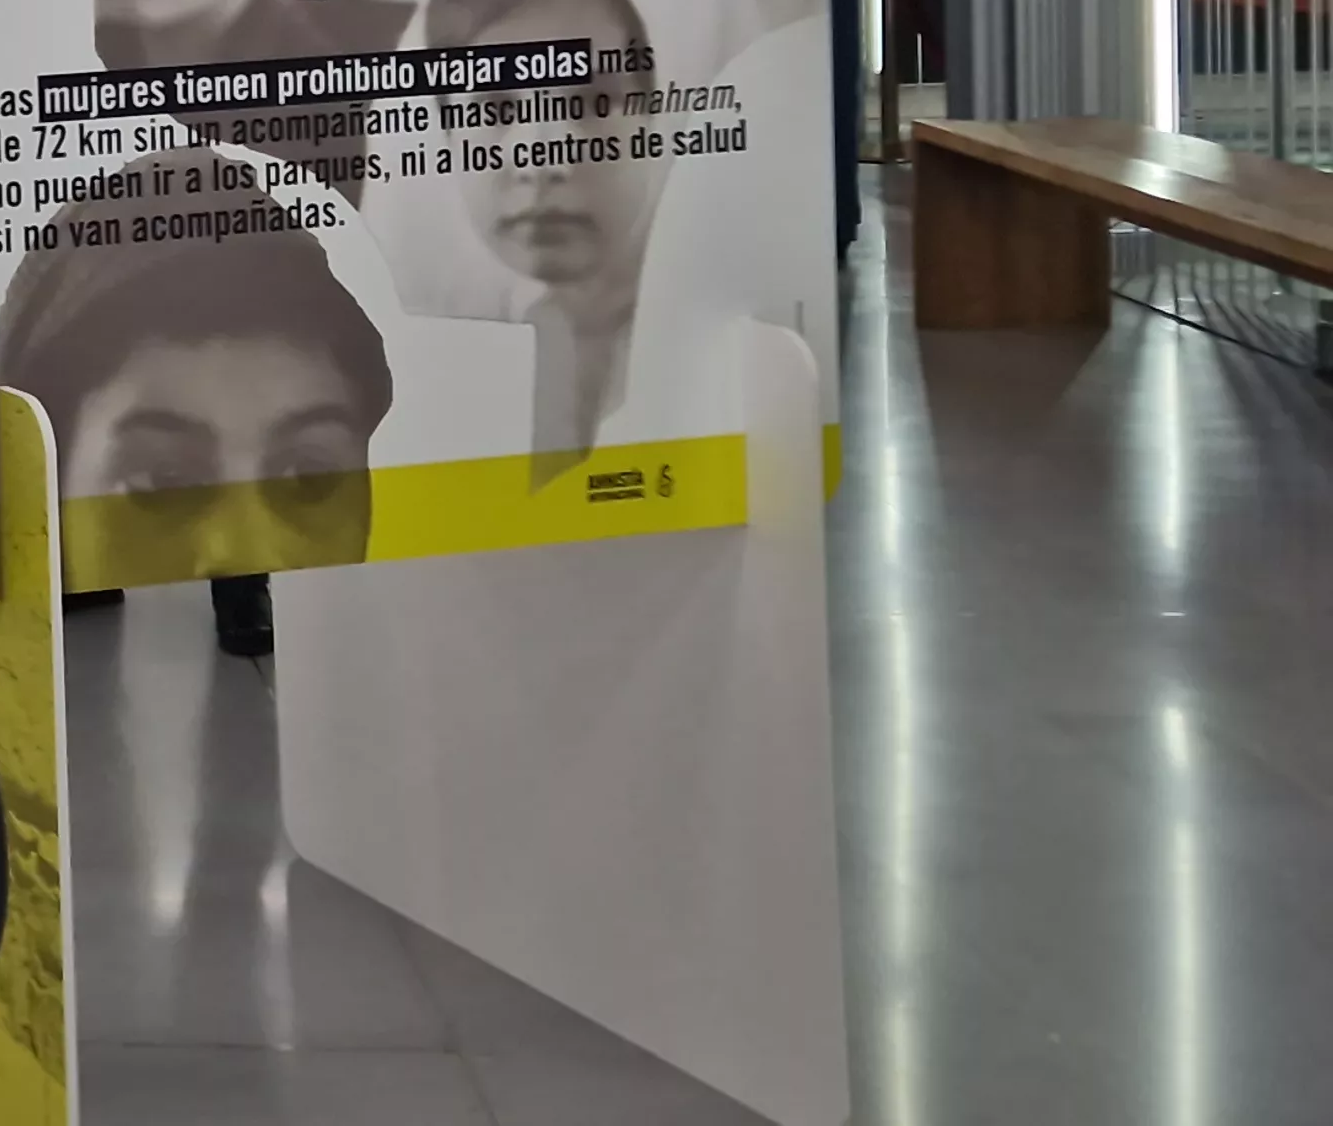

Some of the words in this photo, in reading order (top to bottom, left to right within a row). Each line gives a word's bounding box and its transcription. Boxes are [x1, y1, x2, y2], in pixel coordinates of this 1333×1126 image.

[44, 77, 166, 119] mujeres
[174, 70, 267, 105] tienen
[278, 55, 415, 105] prohibido
[423, 50, 506, 91] viajar
[514, 45, 588, 81] solas
[598, 39, 655, 74] más
[33, 124, 66, 160] 72
[79, 123, 122, 157] km
[134, 118, 174, 152] sin
[187, 121, 221, 147] un
[232, 101, 429, 146] acompañante
[440, 89, 584, 130] masculino
[595, 93, 610, 118] o
[623, 81, 742, 117] mahram,
[34, 166, 142, 212] pueden
[153, 162, 175, 195] ir
[185, 166, 201, 193] a
[213, 159, 254, 191] los
[265, 153, 391, 194] parques,
[401, 142, 426, 177] ni
[436, 147, 452, 175] a
[462, 139, 503, 172] los
[513, 133, 621, 168] centros
[631, 126, 663, 160] de
[672, 119, 747, 156] salud
[23, 223, 58, 252] no
[69, 218, 121, 247] van
[132, 196, 346, 243] acompañadas.
